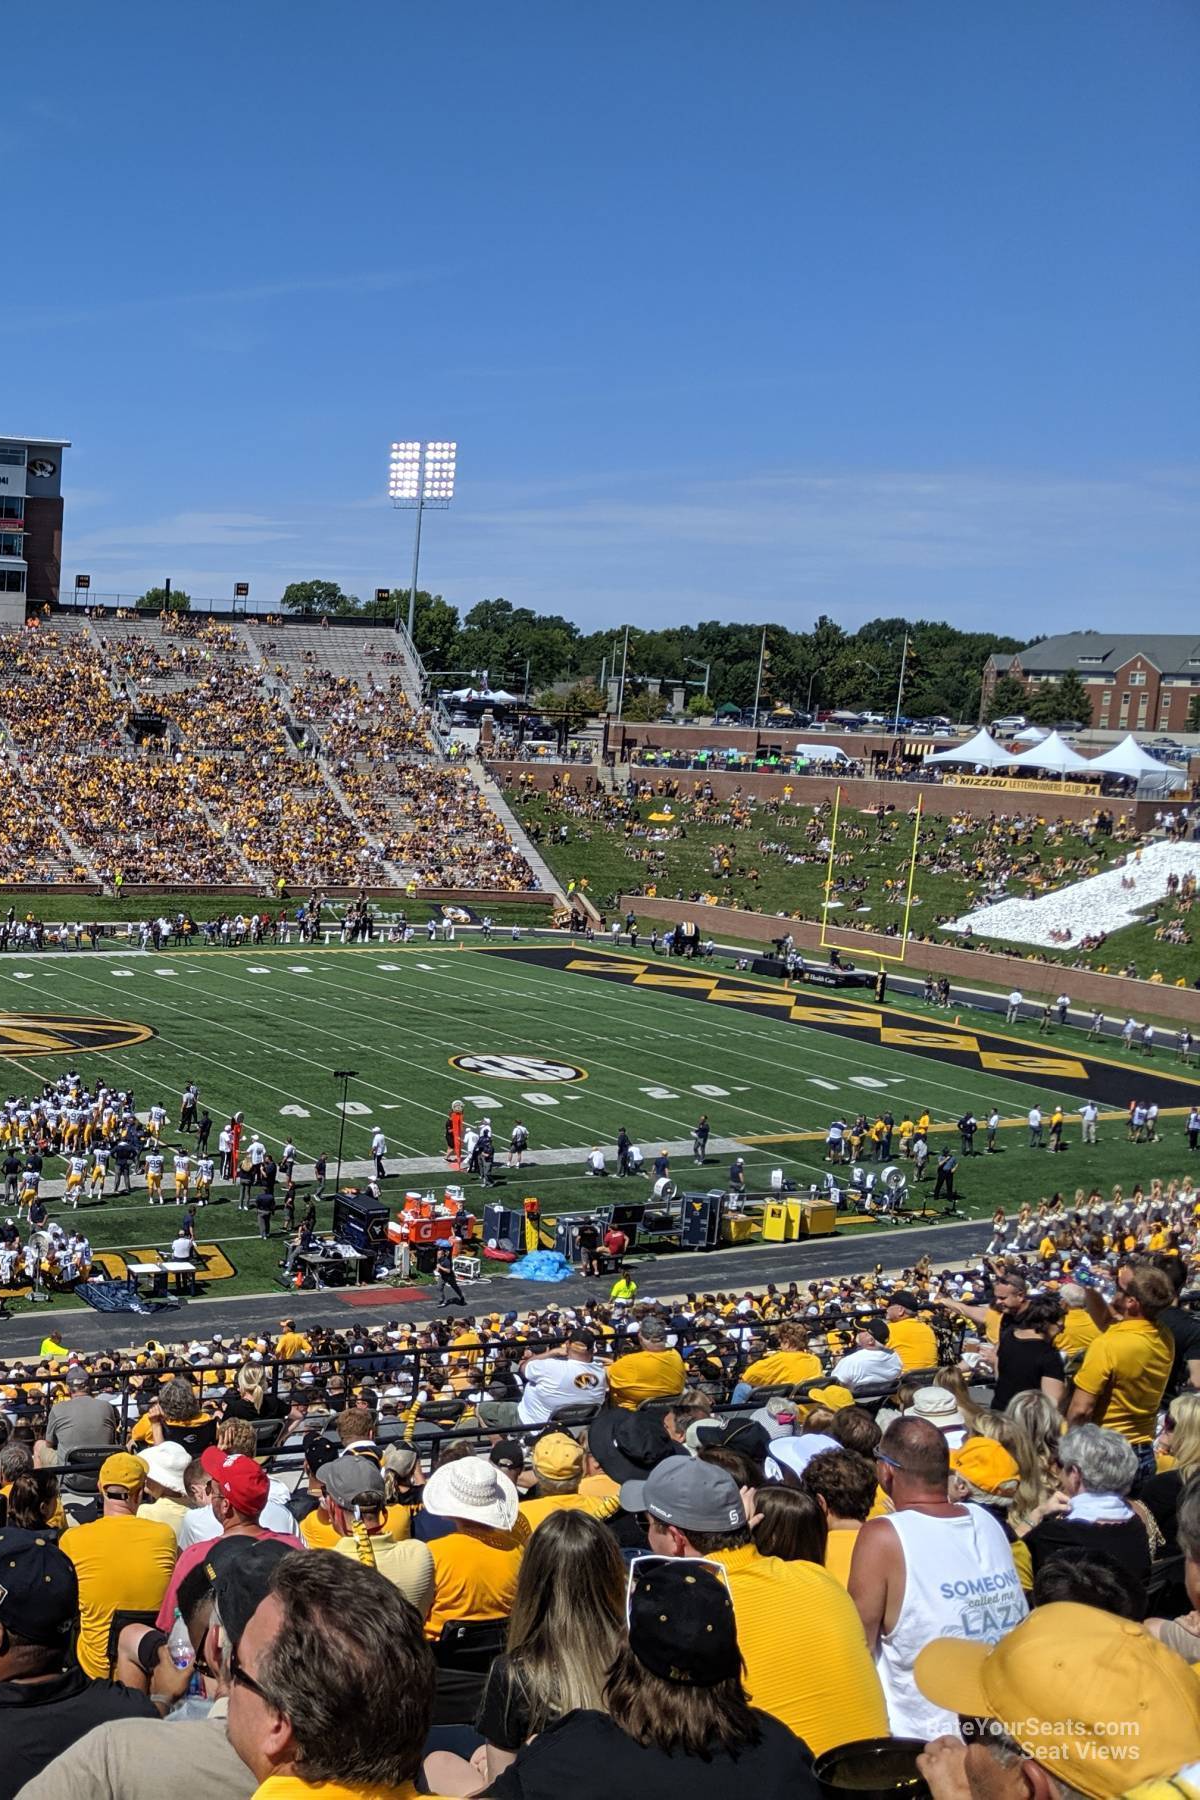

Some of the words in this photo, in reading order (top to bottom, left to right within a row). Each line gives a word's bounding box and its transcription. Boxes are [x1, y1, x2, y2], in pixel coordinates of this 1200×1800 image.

[959, 778, 1008, 788] MIZZOU
[1063, 783, 1082, 793] CLUB
[809, 974, 824, 982] Health
[419, 1224, 432, 1238] G
[968, 1594, 1000, 1608] called
[1001, 1591, 1015, 1602] me
[961, 1600, 1025, 1636] LAZY
